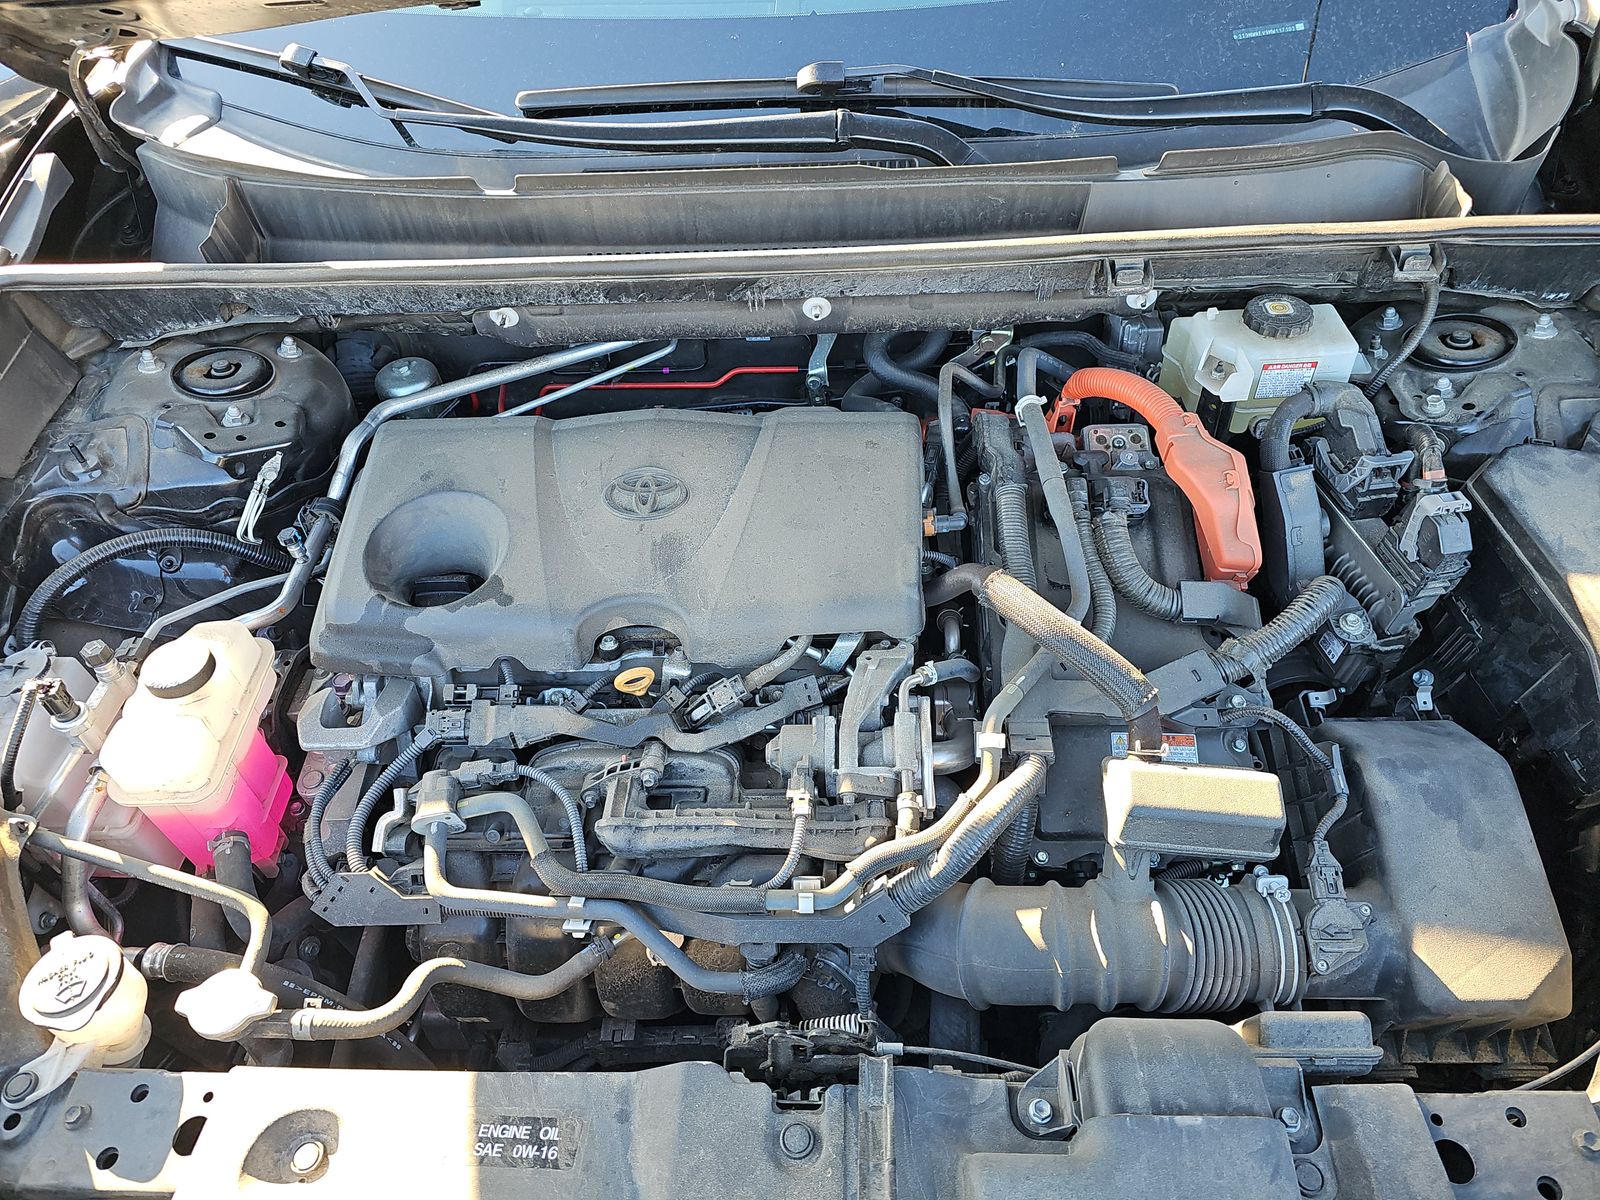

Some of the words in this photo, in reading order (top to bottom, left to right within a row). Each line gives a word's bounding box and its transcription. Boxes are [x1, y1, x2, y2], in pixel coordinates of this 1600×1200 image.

[478, 1124, 532, 1139] ENGINE
[539, 1126, 562, 1140] OIL
[473, 1142, 504, 1157] SAE
[512, 1144, 559, 1160] 0W-16
